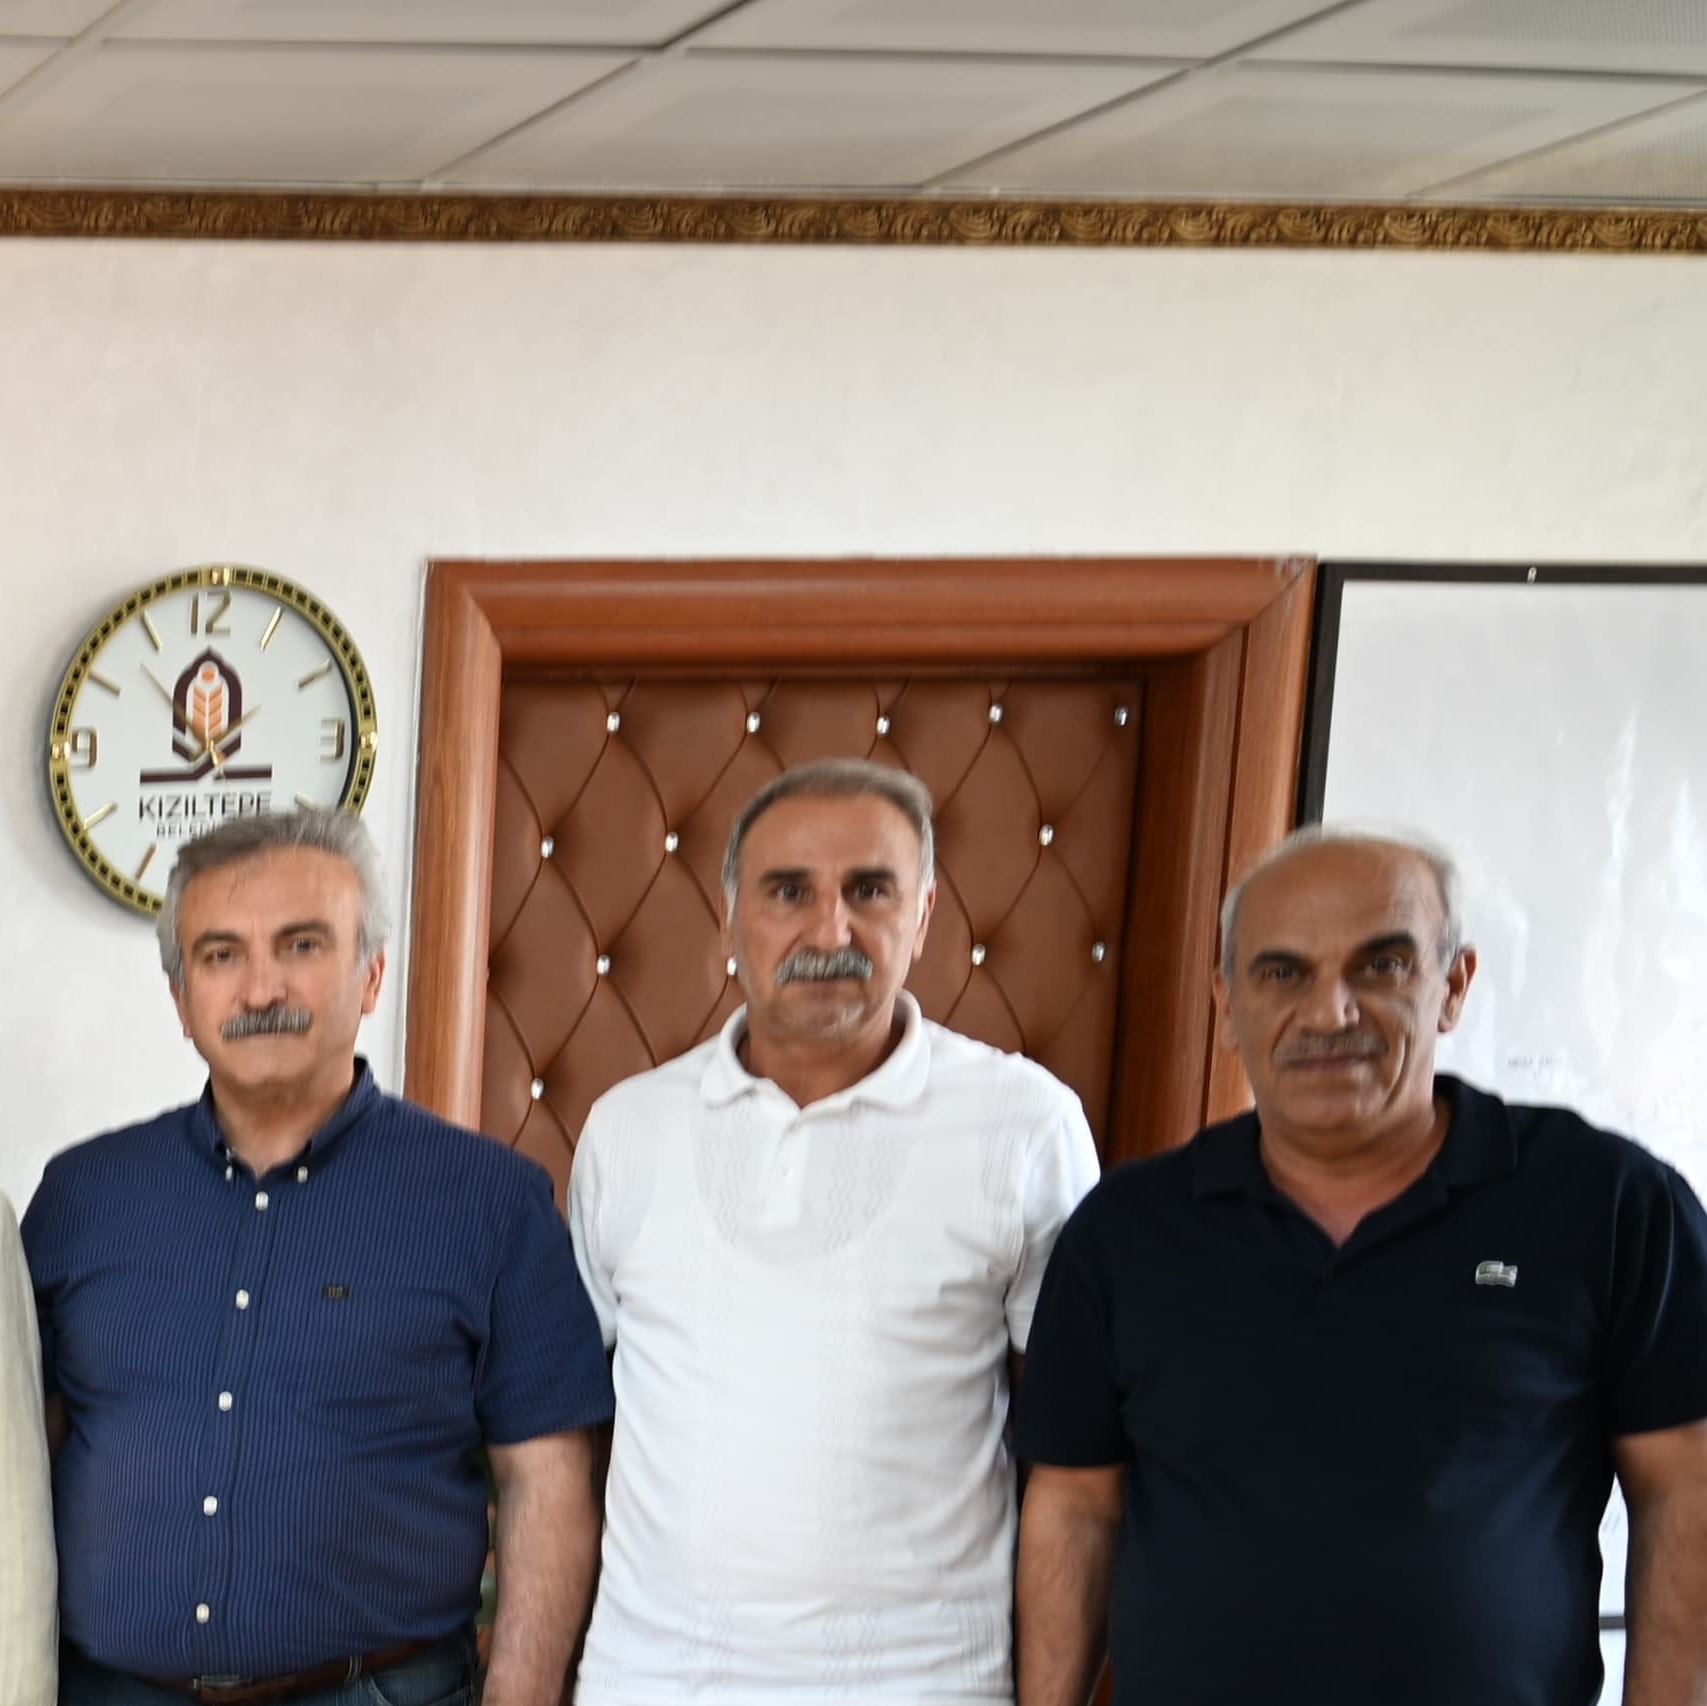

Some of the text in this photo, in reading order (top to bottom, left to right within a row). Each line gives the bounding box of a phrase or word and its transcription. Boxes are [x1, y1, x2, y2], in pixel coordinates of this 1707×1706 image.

[190, 589, 231, 637] 12
[71, 726, 97, 773] 9
[320, 717, 345, 765] 3
[139, 791, 271, 820] KIZILTEPE
